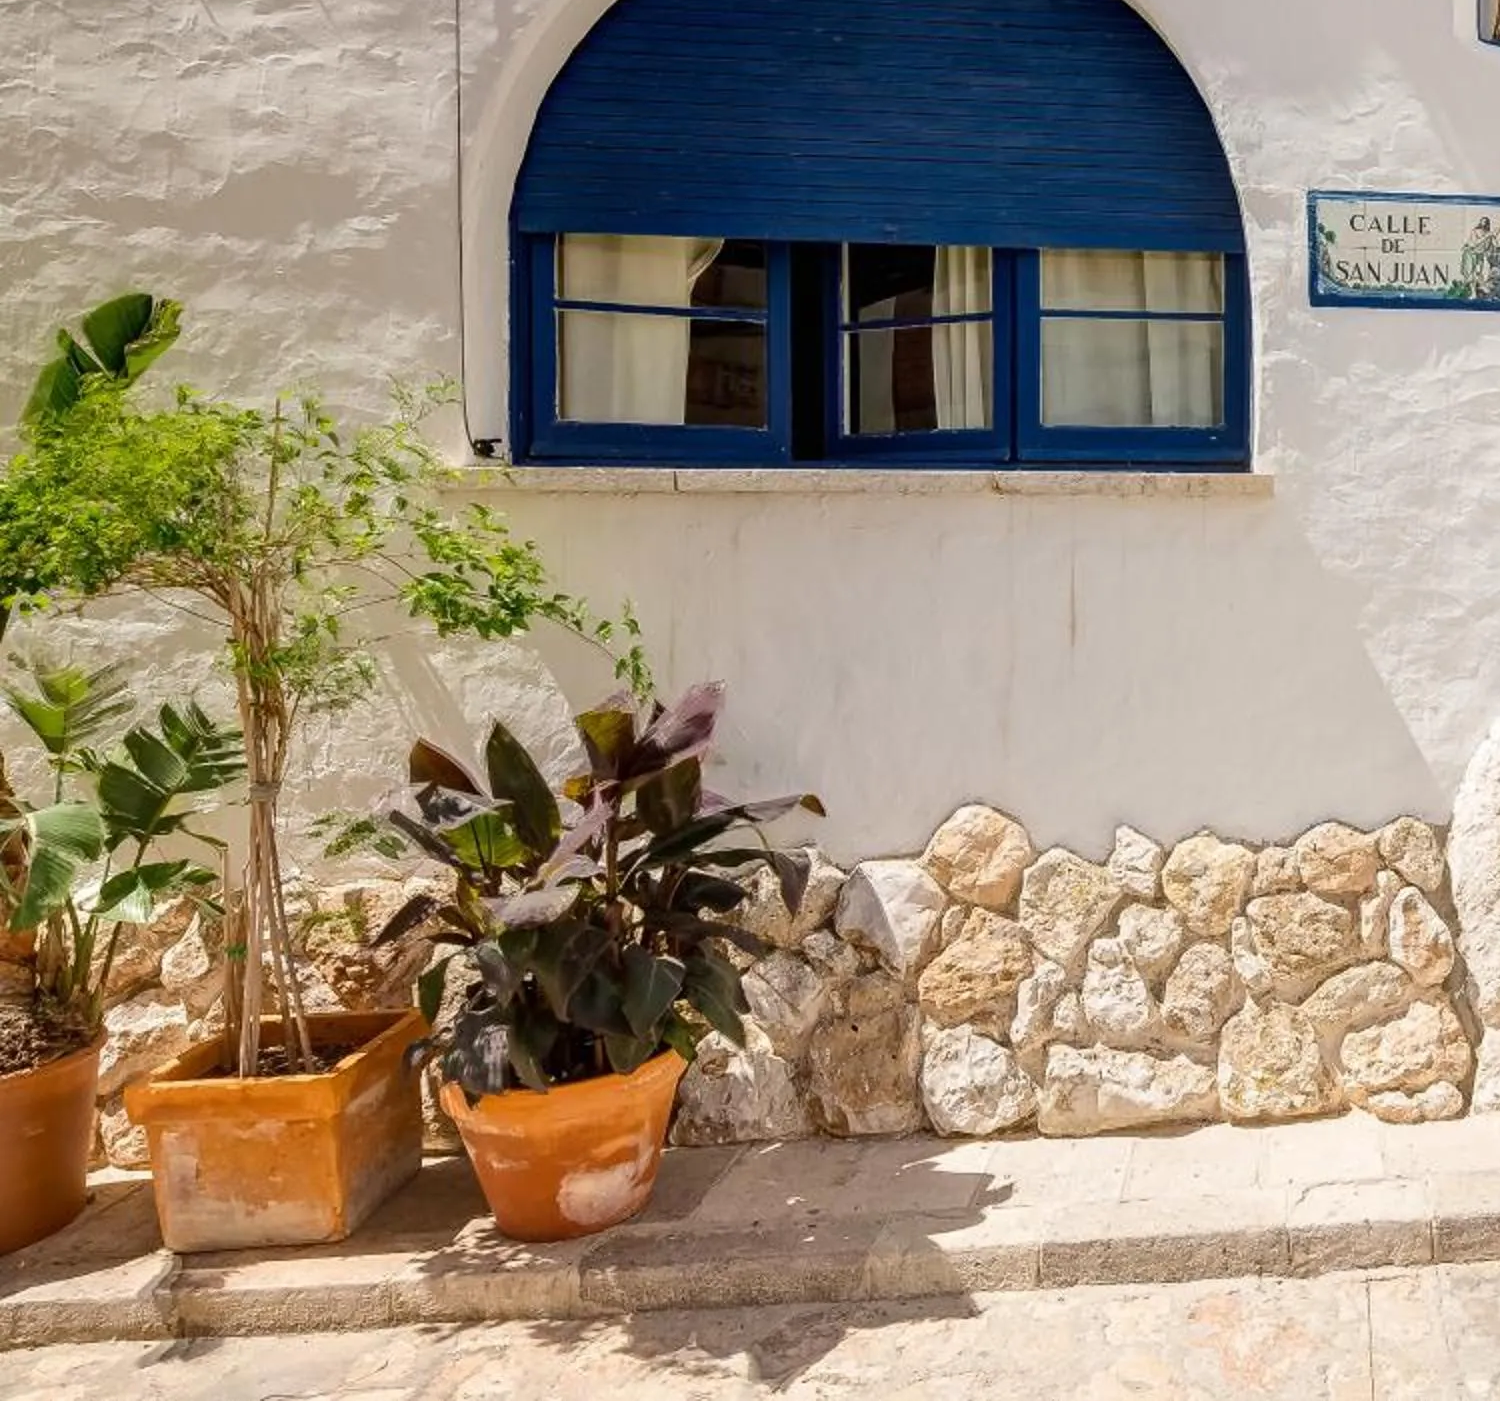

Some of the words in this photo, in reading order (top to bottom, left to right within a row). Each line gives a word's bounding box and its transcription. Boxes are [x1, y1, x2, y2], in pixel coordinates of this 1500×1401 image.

[1350, 214, 1431, 235] CALLE
[1382, 238, 1405, 254] DE
[1335, 260, 1381, 283] SAN
[1387, 262, 1449, 286] JUAN
